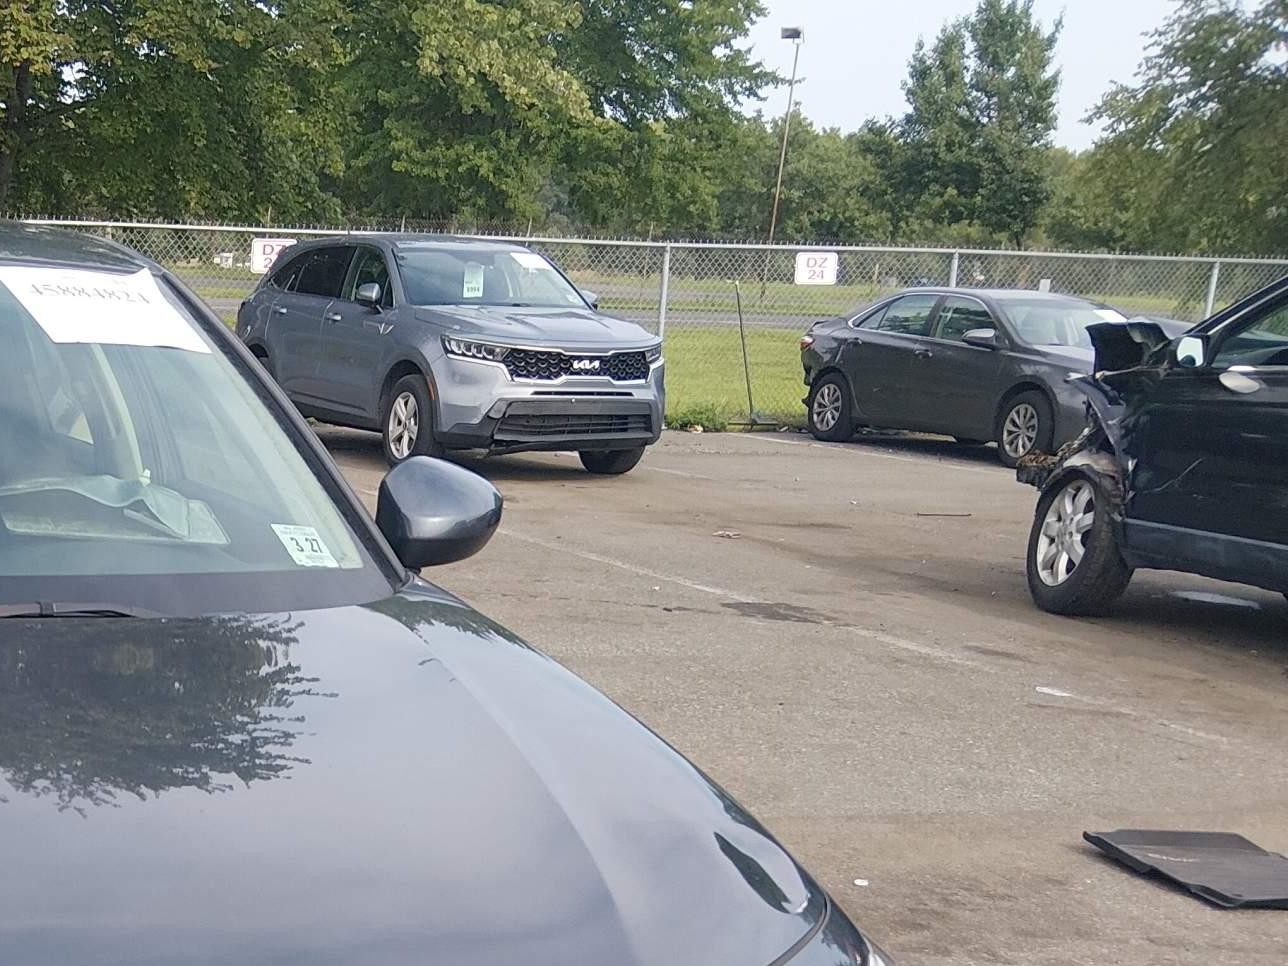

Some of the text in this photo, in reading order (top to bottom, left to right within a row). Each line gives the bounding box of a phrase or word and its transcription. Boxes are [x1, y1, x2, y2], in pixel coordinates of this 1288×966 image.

[806, 256, 828, 269] DZ
[289, 536, 324, 554] 3 27
